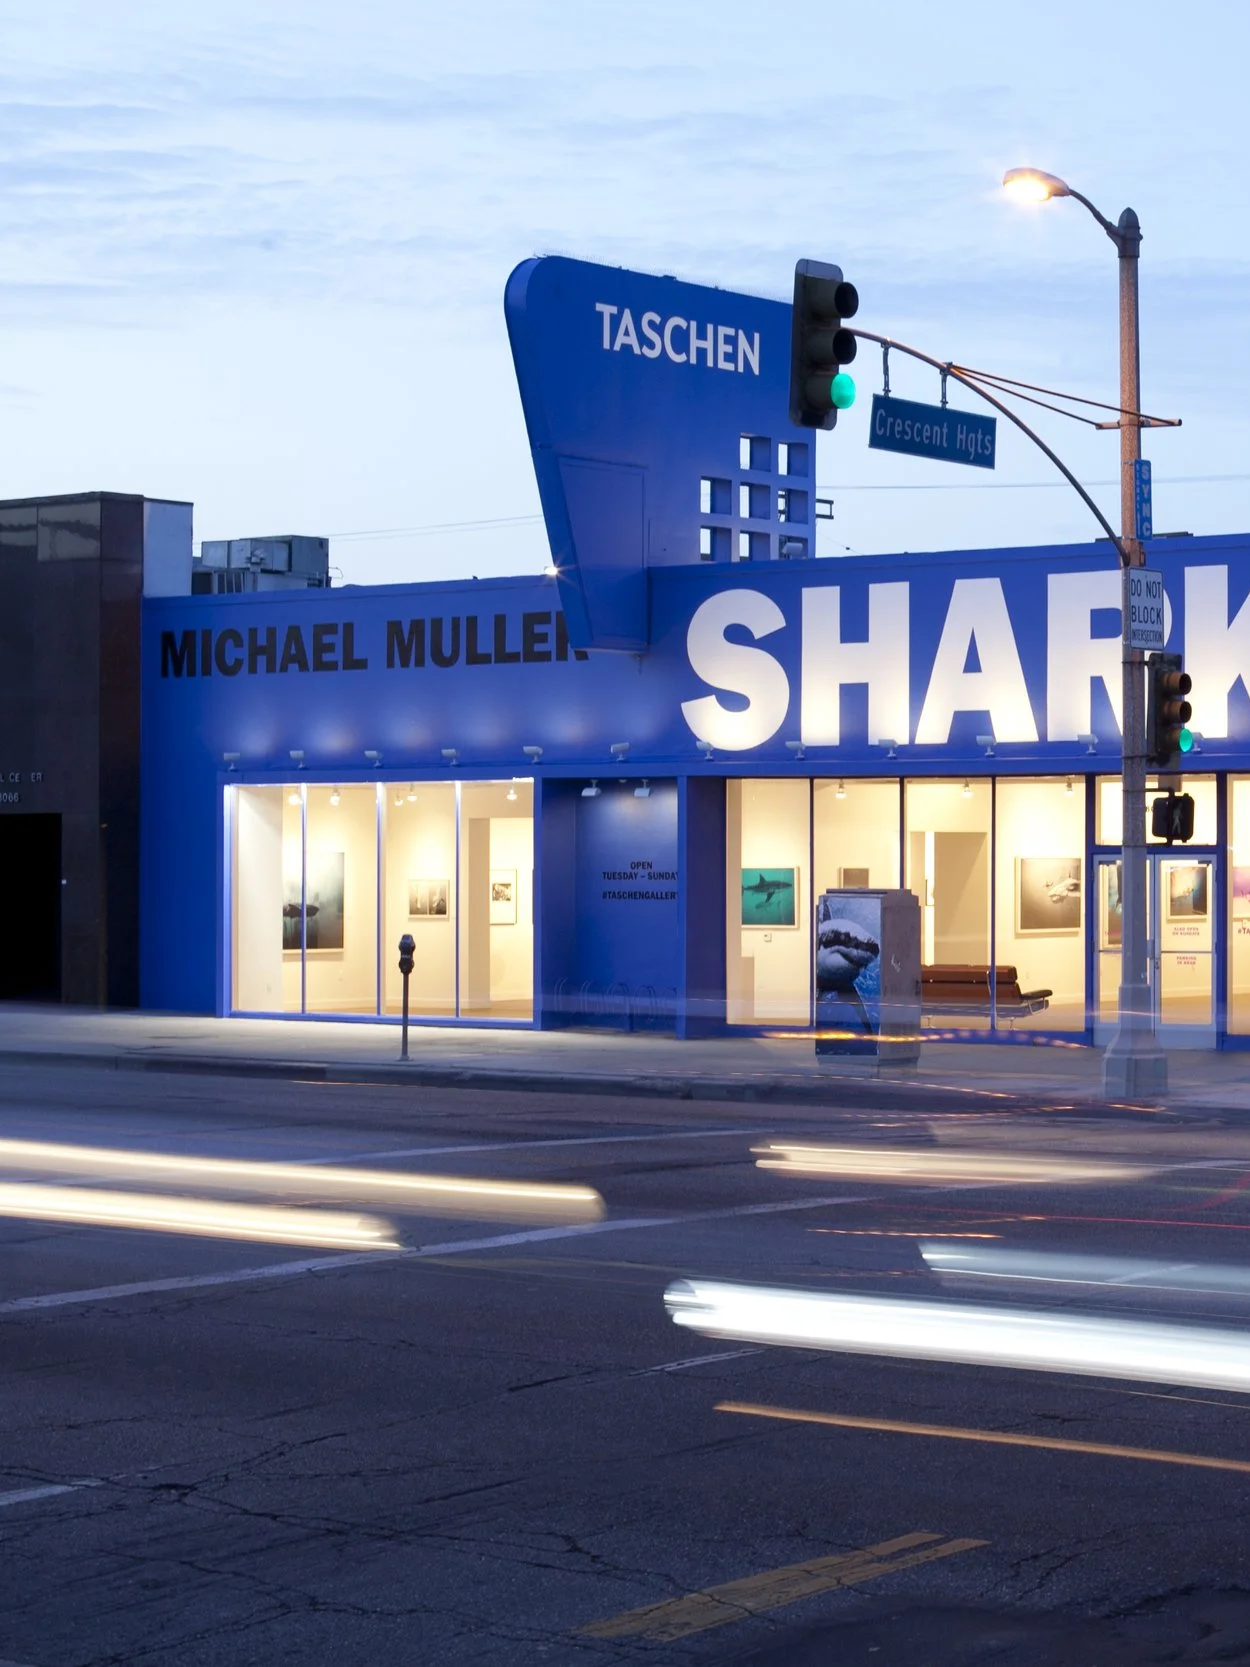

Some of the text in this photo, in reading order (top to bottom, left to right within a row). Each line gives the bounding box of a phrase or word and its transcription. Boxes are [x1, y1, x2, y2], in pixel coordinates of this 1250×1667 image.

[596, 302, 760, 376] TASCHEN
[875, 408, 993, 460] Crescent Hgts
[1141, 464, 1152, 537] SYNC
[1131, 579, 1161, 598] DO NOT
[1131, 605, 1162, 625] BLOCK
[1131, 630, 1162, 642] INTERSECTION
[160, 621, 368, 679] MICHAEL
[630, 861, 653, 870] OPEN
[602, 871, 638, 881] TUESDAY
[602, 891, 678, 901] #TASCHENGALLER
